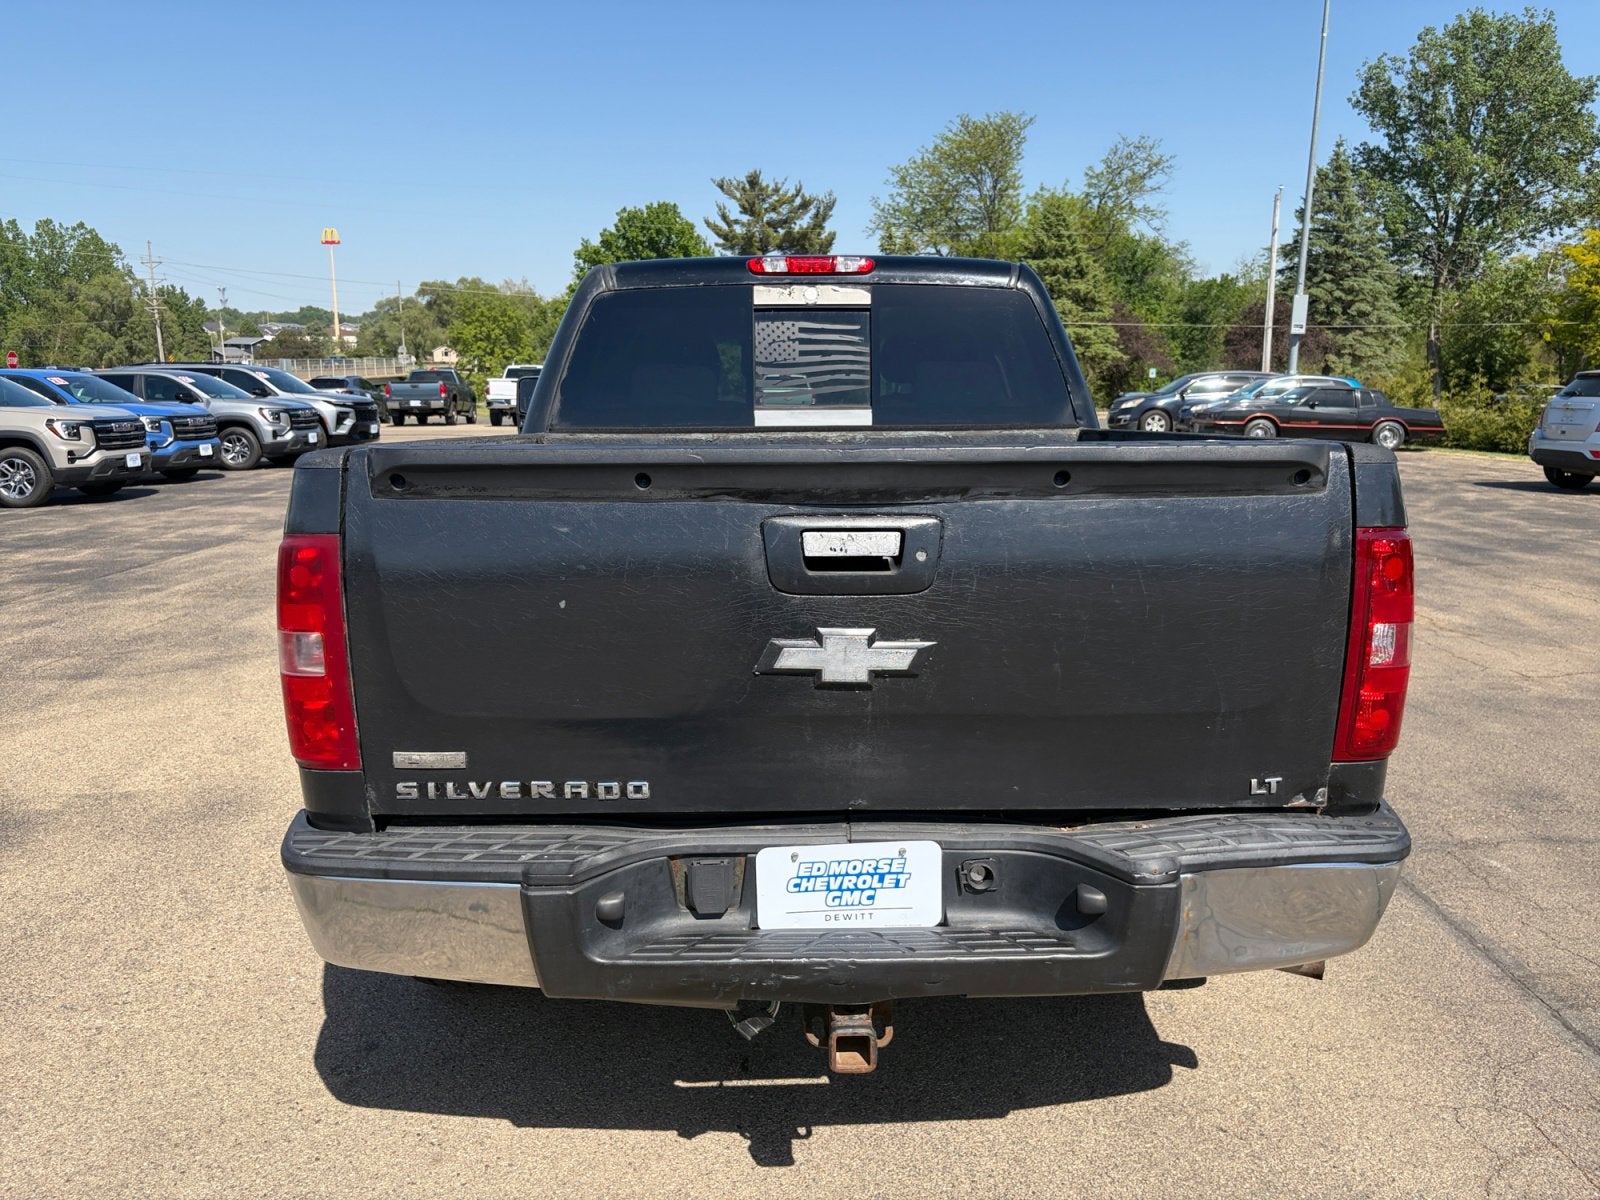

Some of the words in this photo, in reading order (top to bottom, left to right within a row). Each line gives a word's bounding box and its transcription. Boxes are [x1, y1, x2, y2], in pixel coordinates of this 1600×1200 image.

[8, 356, 18, 365] STOP
[396, 780, 651, 800] SILVERADO
[1250, 777, 1283, 795] LT
[797, 861, 827, 877] ED
[828, 857, 907, 876] MORSE
[786, 873, 912, 893] CHEVROLET
[825, 889, 877, 907] GMC
[825, 912, 875, 922] DEWITT
